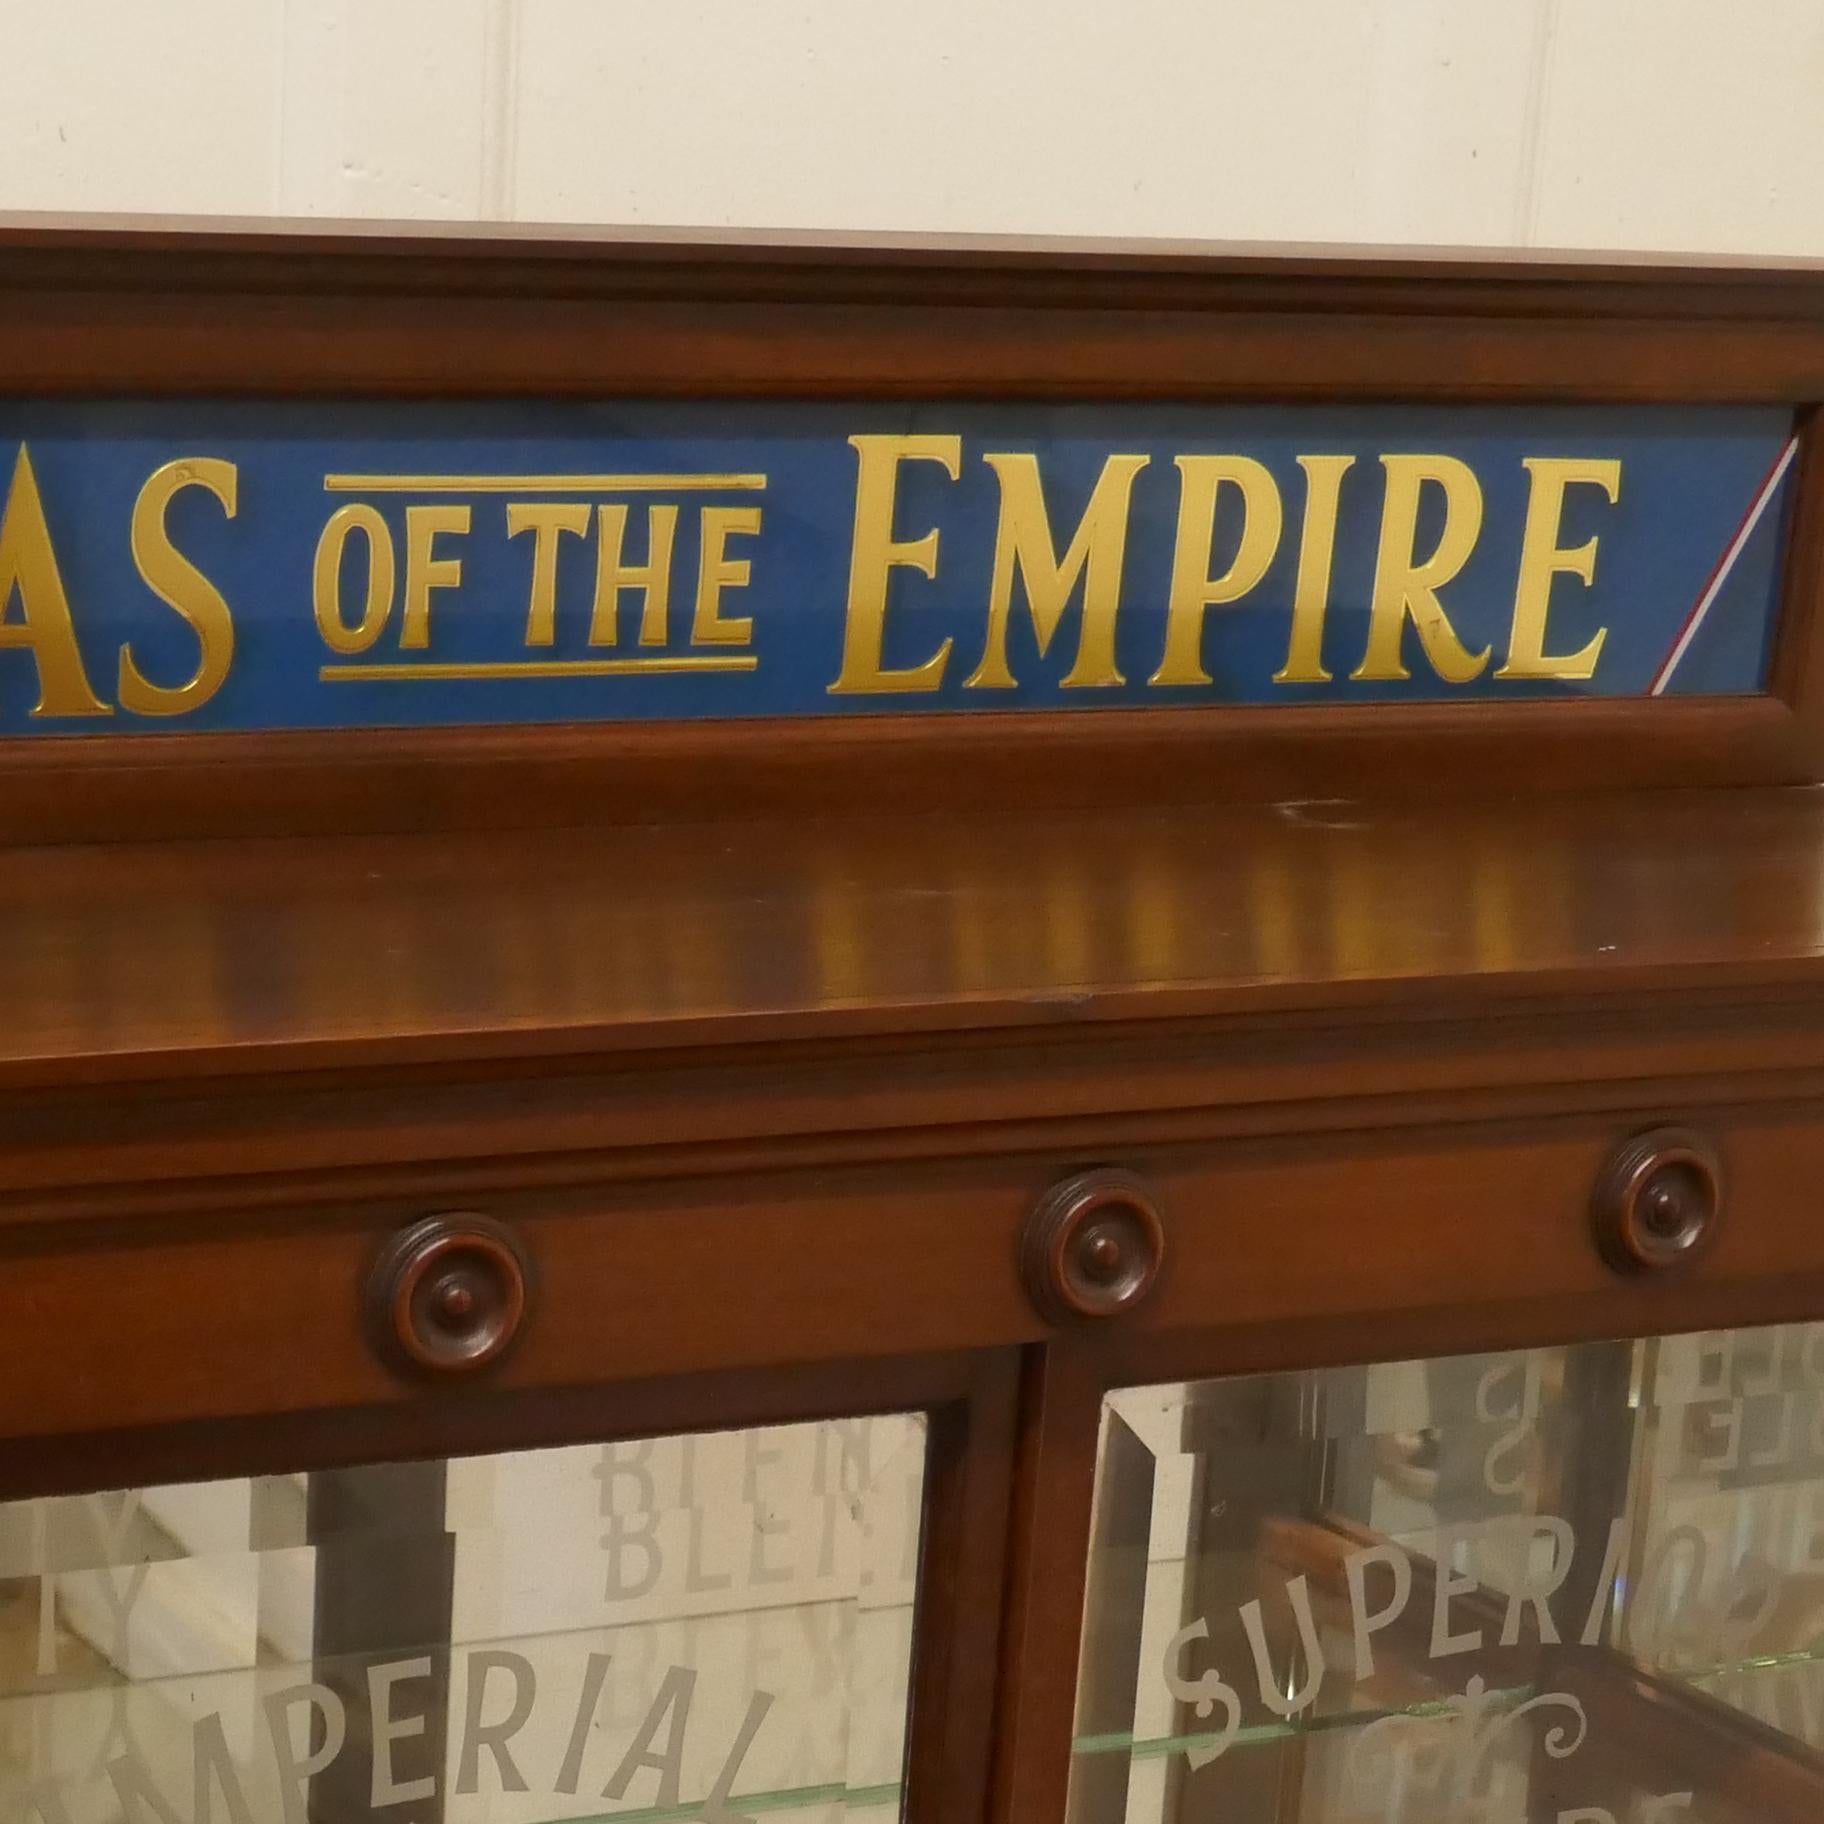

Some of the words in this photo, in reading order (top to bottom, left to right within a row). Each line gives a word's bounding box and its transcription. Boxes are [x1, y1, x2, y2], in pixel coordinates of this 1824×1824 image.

[312, 500, 464, 656] OF
[506, 503, 763, 650] THE
[825, 432, 1622, 695] EMPIRE
